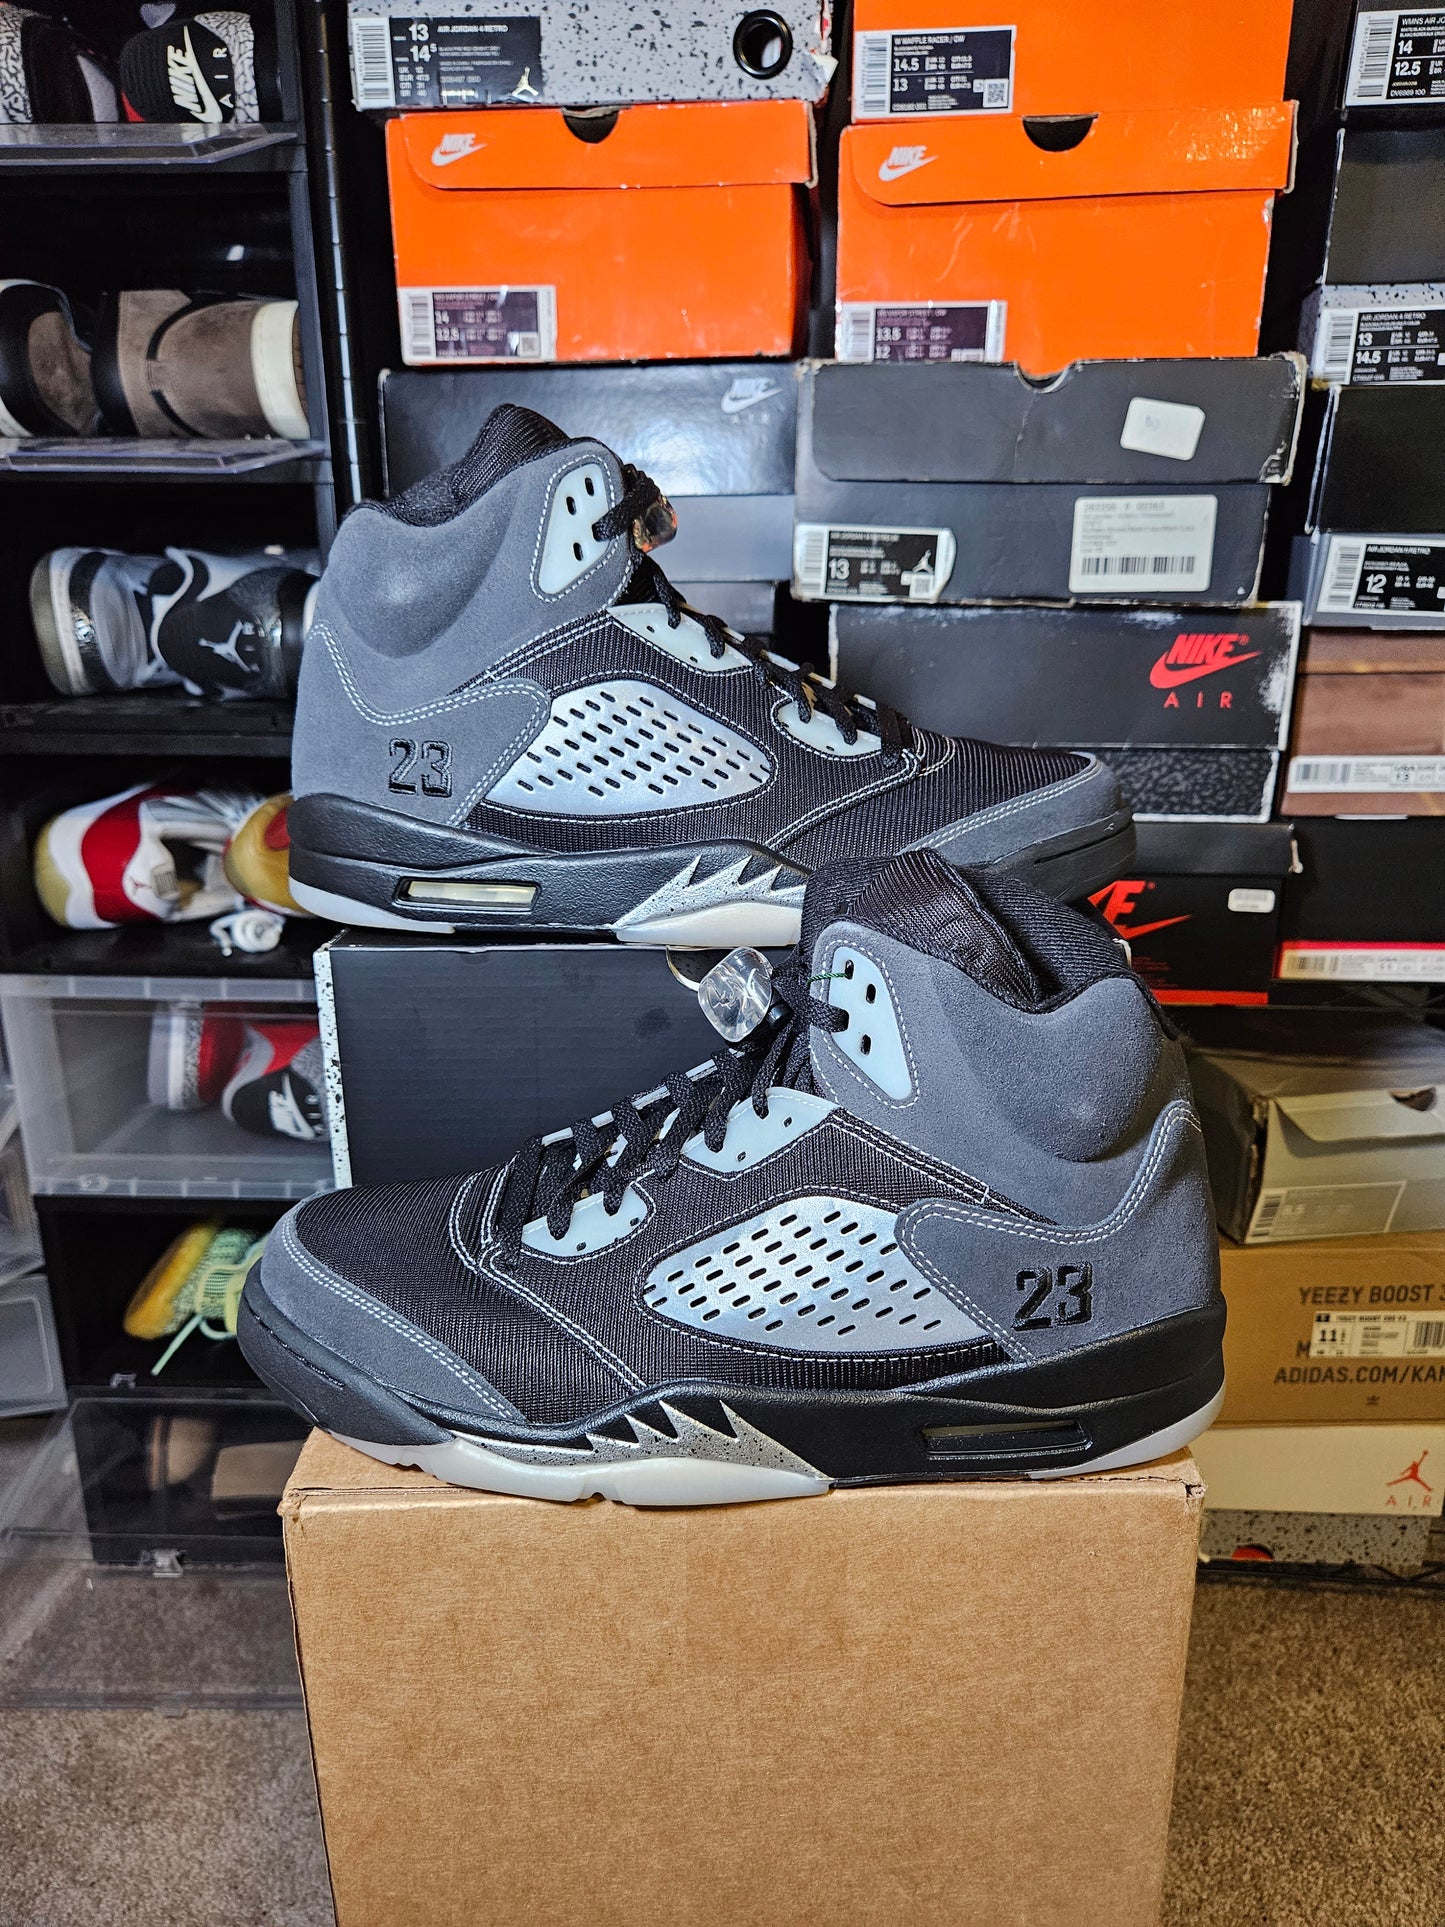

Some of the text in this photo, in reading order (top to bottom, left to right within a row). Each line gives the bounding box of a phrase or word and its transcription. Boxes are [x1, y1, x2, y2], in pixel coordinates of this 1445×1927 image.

[1402, 17, 1423, 25] WMNS
[1424, 16, 1436, 25] AIR
[409, 24, 429, 41] 13
[1398, 40, 1413, 54] 14
[893, 57, 920, 72] 14.5
[1395, 61, 1421, 76] 12.5
[167, 45, 203, 113] NIKE
[212, 47, 234, 108] AIR
[892, 78, 909, 92] 13
[441, 133, 477, 153] NIKE
[888, 145, 928, 167] NIKE
[435, 311, 449, 324] 14
[876, 327, 902, 341] 13.5
[1358, 333, 1373, 346] 13
[876, 345, 891, 359] 12
[1356, 350, 1381, 364] 14.5
[730, 378, 771, 399] NIKE
[828, 558, 850, 580] 13
[1365, 574, 1387, 593] 12
[1165, 633, 1240, 665] NIKE
[1163, 691, 1233, 708] AIR
[389, 738, 453, 798] 23
[1011, 1261, 1093, 1331] 23
[1299, 1284, 1434, 1305] YEEZY BOOST
[1385, 1494, 1432, 1508] AIR
